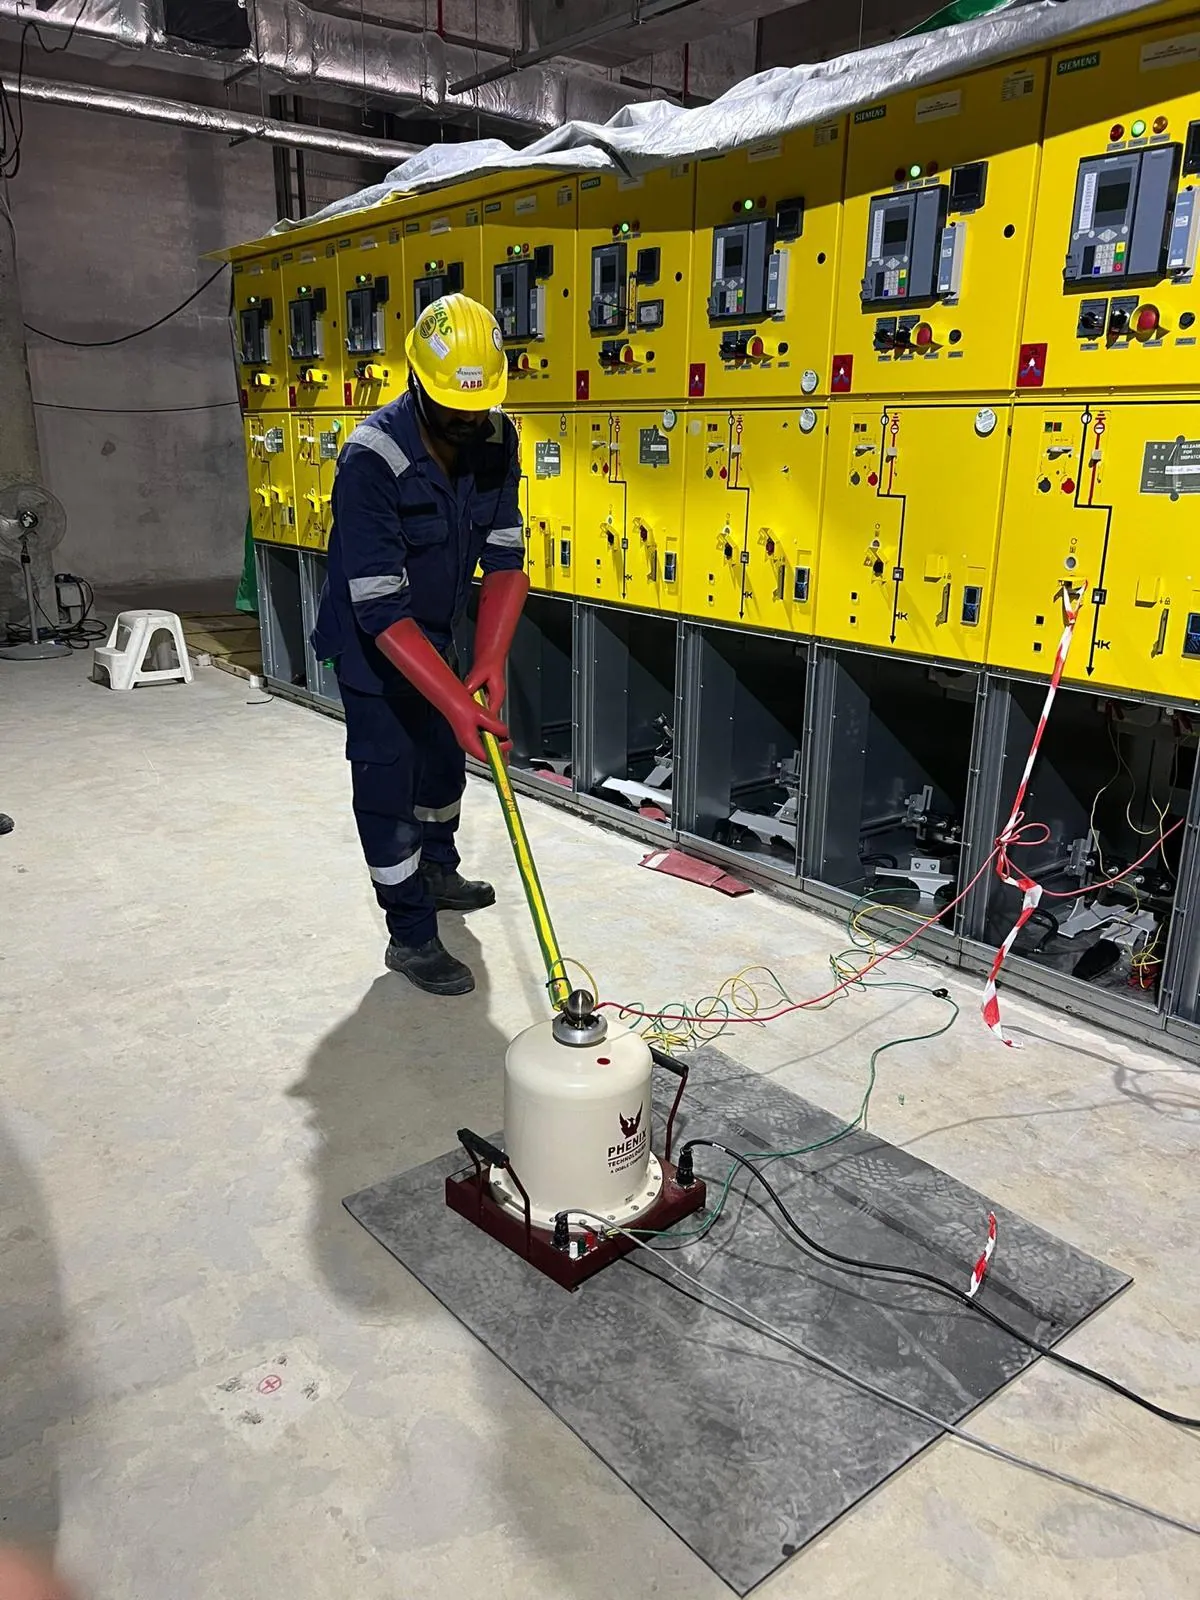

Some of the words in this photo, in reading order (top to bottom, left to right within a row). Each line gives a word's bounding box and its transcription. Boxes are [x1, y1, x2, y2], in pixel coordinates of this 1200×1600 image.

[1059, 55, 1097, 72] SIEMENS
[461, 380, 483, 389] ABB
[608, 1128, 647, 1157] PHENIX
